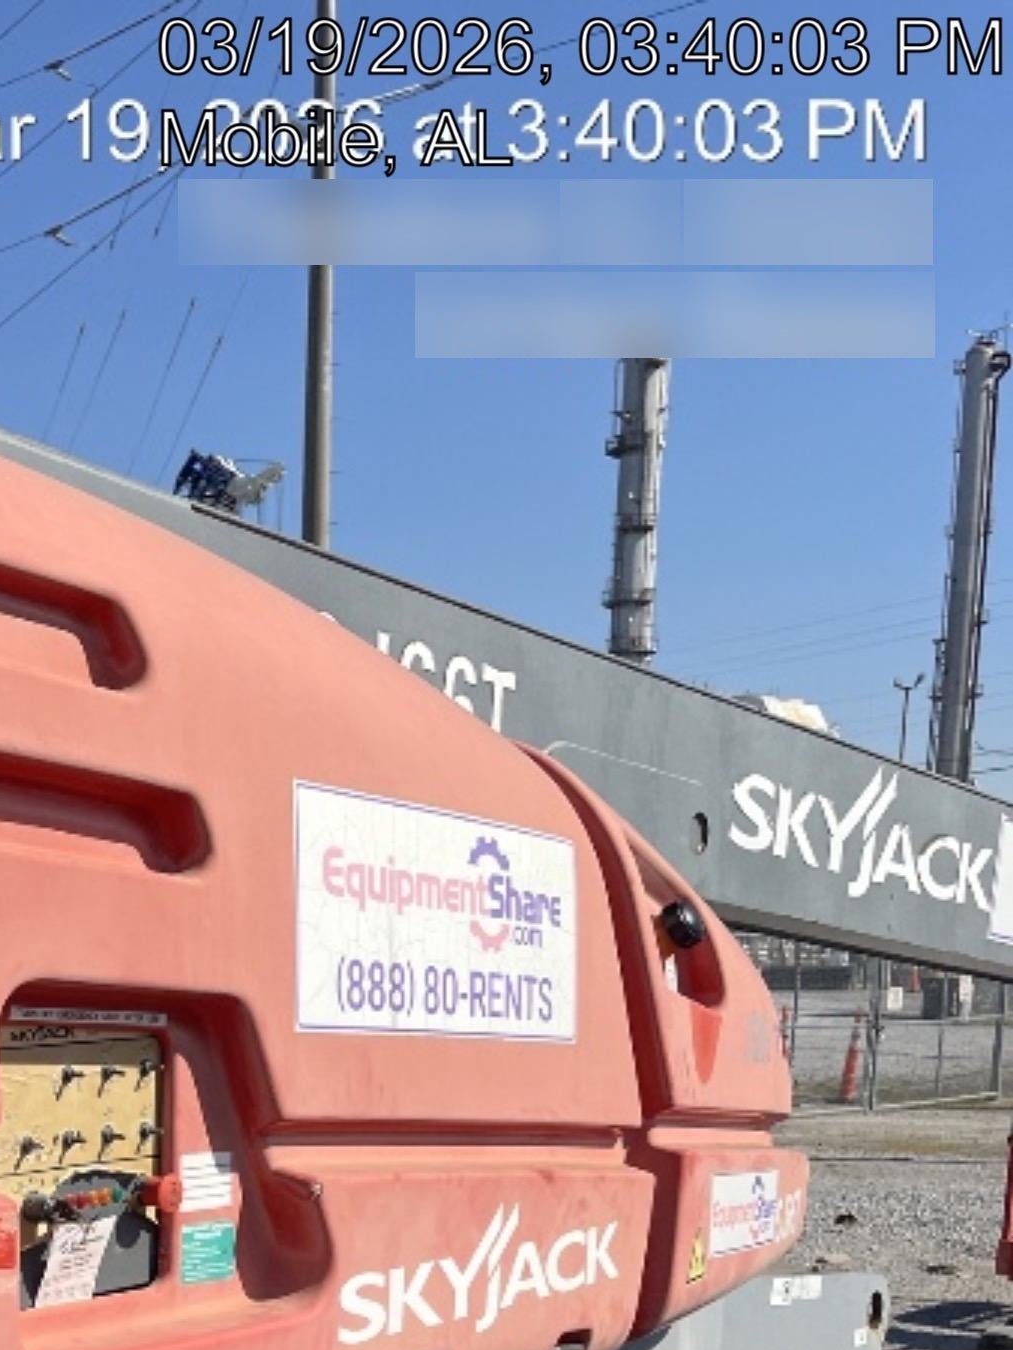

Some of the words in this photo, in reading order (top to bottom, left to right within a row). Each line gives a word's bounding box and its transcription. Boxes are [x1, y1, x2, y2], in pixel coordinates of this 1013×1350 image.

[322, 845, 562, 928] EquipmentShare
[728, 766, 994, 911] SKYJACK
[337, 956, 415, 1017] (888)
[422, 964, 553, 1023] 80-RENTS
[337, 1202, 619, 1344] SKYJACK
